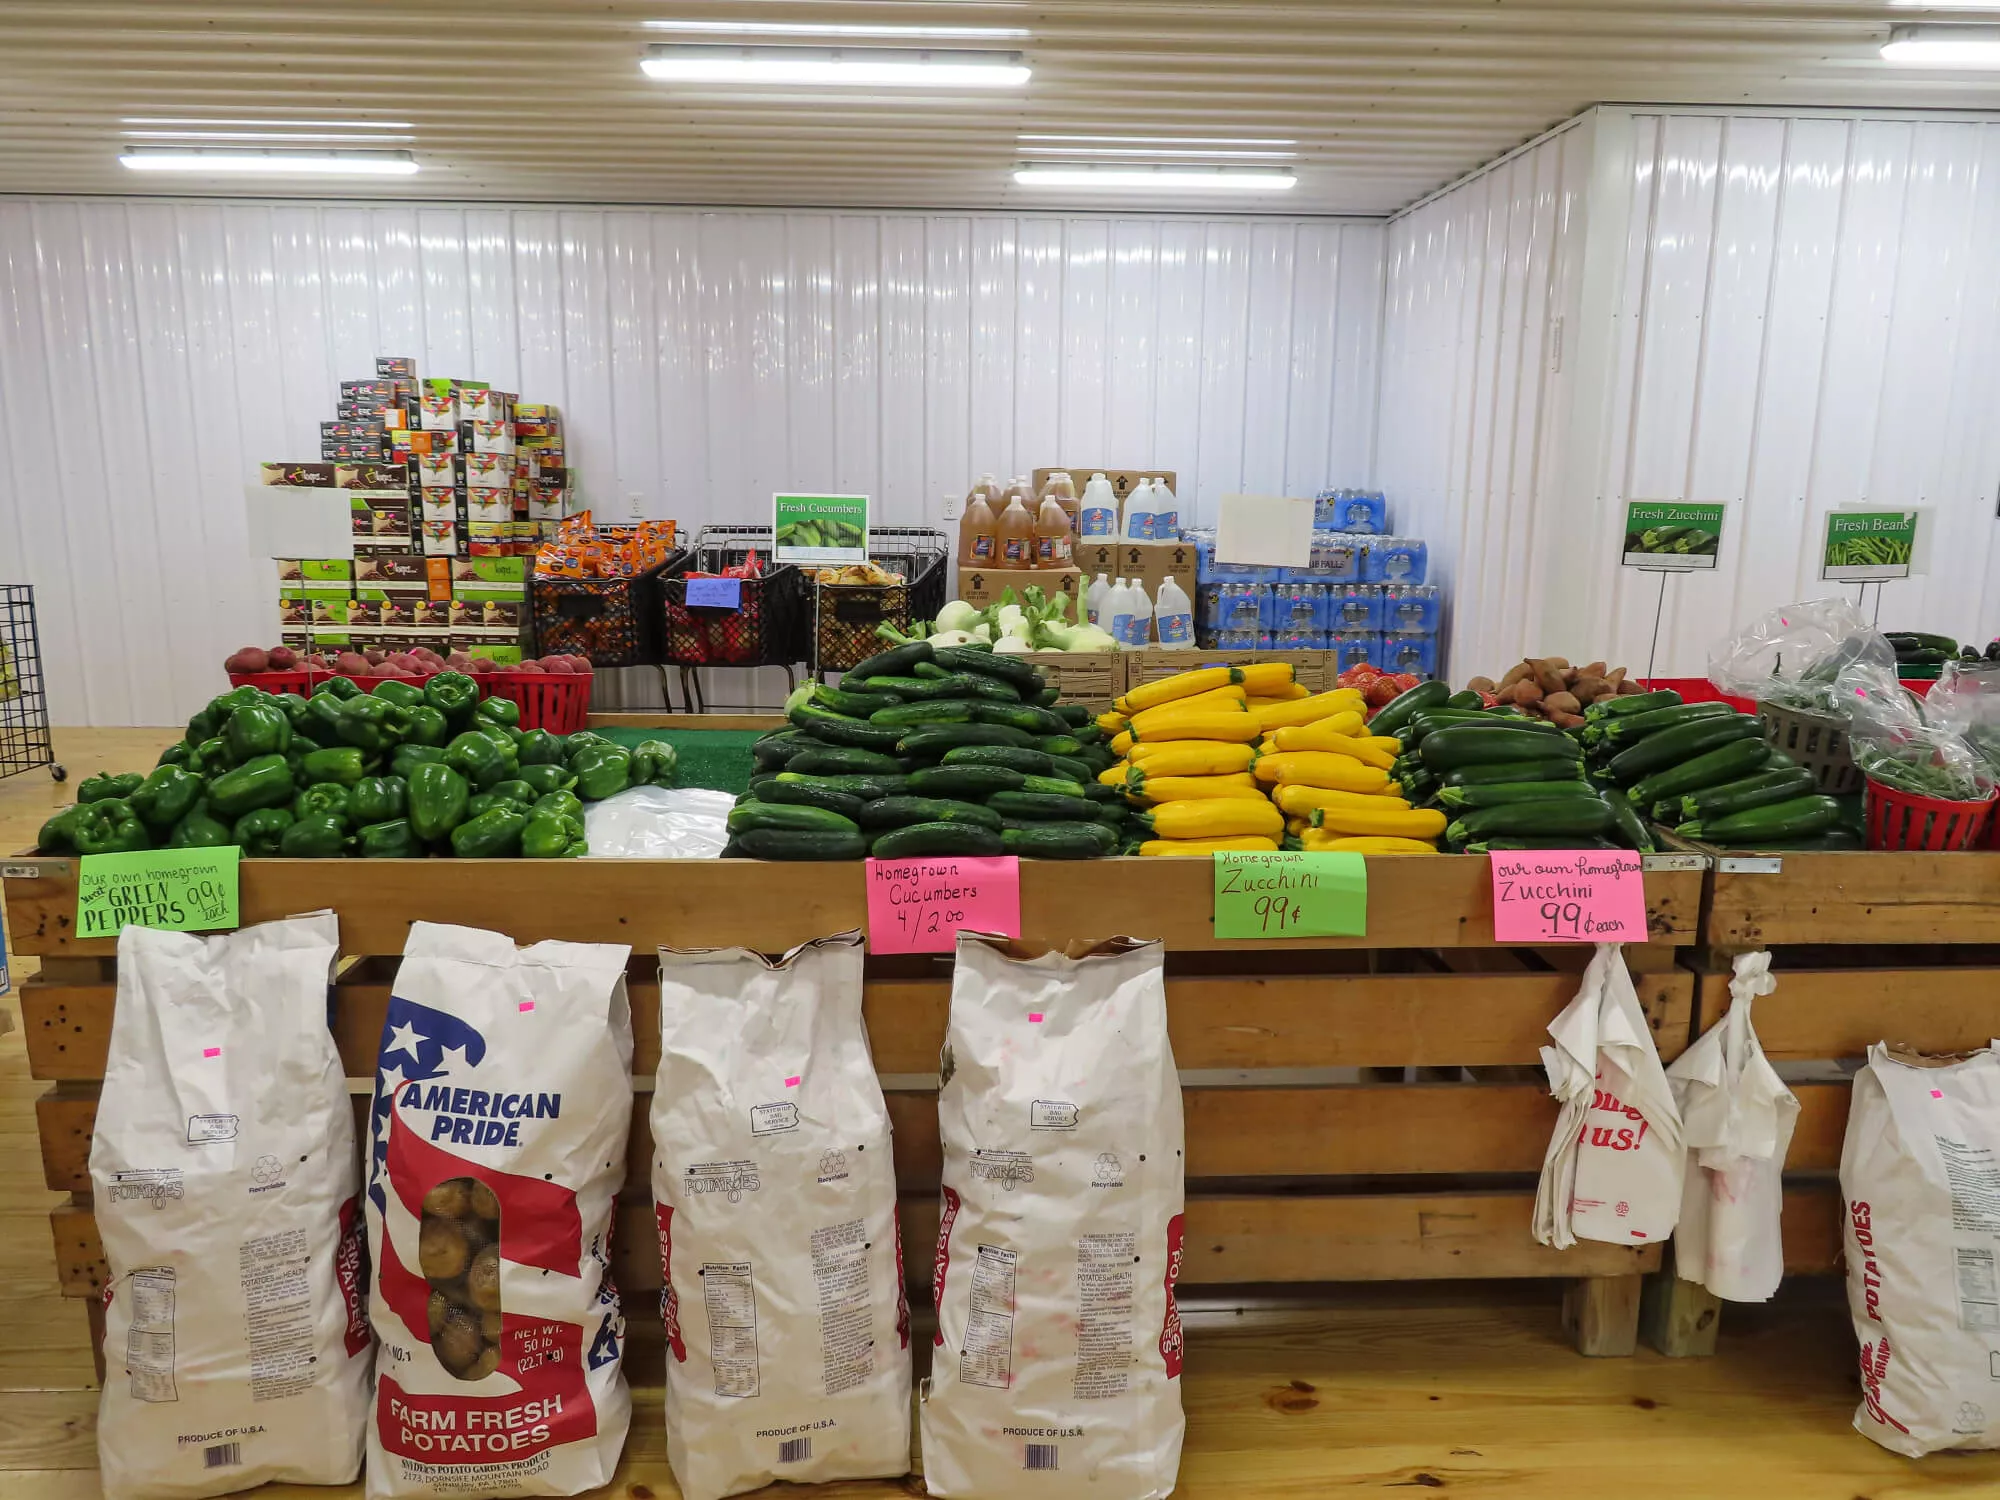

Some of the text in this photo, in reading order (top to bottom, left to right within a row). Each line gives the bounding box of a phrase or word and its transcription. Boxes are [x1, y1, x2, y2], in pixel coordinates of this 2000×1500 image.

[780, 502, 862, 514] Fresh Cucumbers
[1632, 507, 1719, 521] Fresh Zucchini
[1835, 518, 1909, 531] Fresh Beans
[112, 871, 141, 883] own
[146, 864, 218, 884] homegrown
[875, 863, 959, 886] Homegrown
[1221, 865, 1320, 894] Zucchini
[108, 882, 169, 907] GREEN
[889, 881, 978, 905] Cucumbers
[1499, 881, 1593, 901] Zucchini
[83, 901, 185, 932] PEPPERS
[400, 1083, 561, 1119] AMERICAN
[431, 1115, 520, 1147] PRIDE
[1591, 1120, 1649, 1151] us!
[248, 1181, 287, 1194] Recyclable
[816, 1172, 849, 1184] Recyclable
[1091, 1180, 1124, 1188] Recyclable
[1851, 1200, 1882, 1323] POTATOES
[1078, 1273, 1106, 1282] POTATOES
[514, 1324, 563, 1341] NET WT.
[524, 1337, 552, 1354] 50 lb
[517, 1353, 544, 1375] (22.7
[1873, 1337, 1891, 1379] BRAND
[390, 1394, 564, 1431] FARM FRESH
[178, 1425, 267, 1444] PRODUCE OF U.S.A.
[401, 1424, 550, 1453] POTATOES
[756, 1419, 837, 1438] PRODUCE OF U.S.A.
[1003, 1427, 1085, 1438] PRODUCE OF U.S.A.
[438, 1464, 471, 1474] POTATO
[473, 1463, 510, 1474] GARDEN
[511, 1450, 553, 1470] PRODUCE
[471, 1469, 523, 1481] MOUNTAIN
[524, 1461, 550, 1476] ROAD
